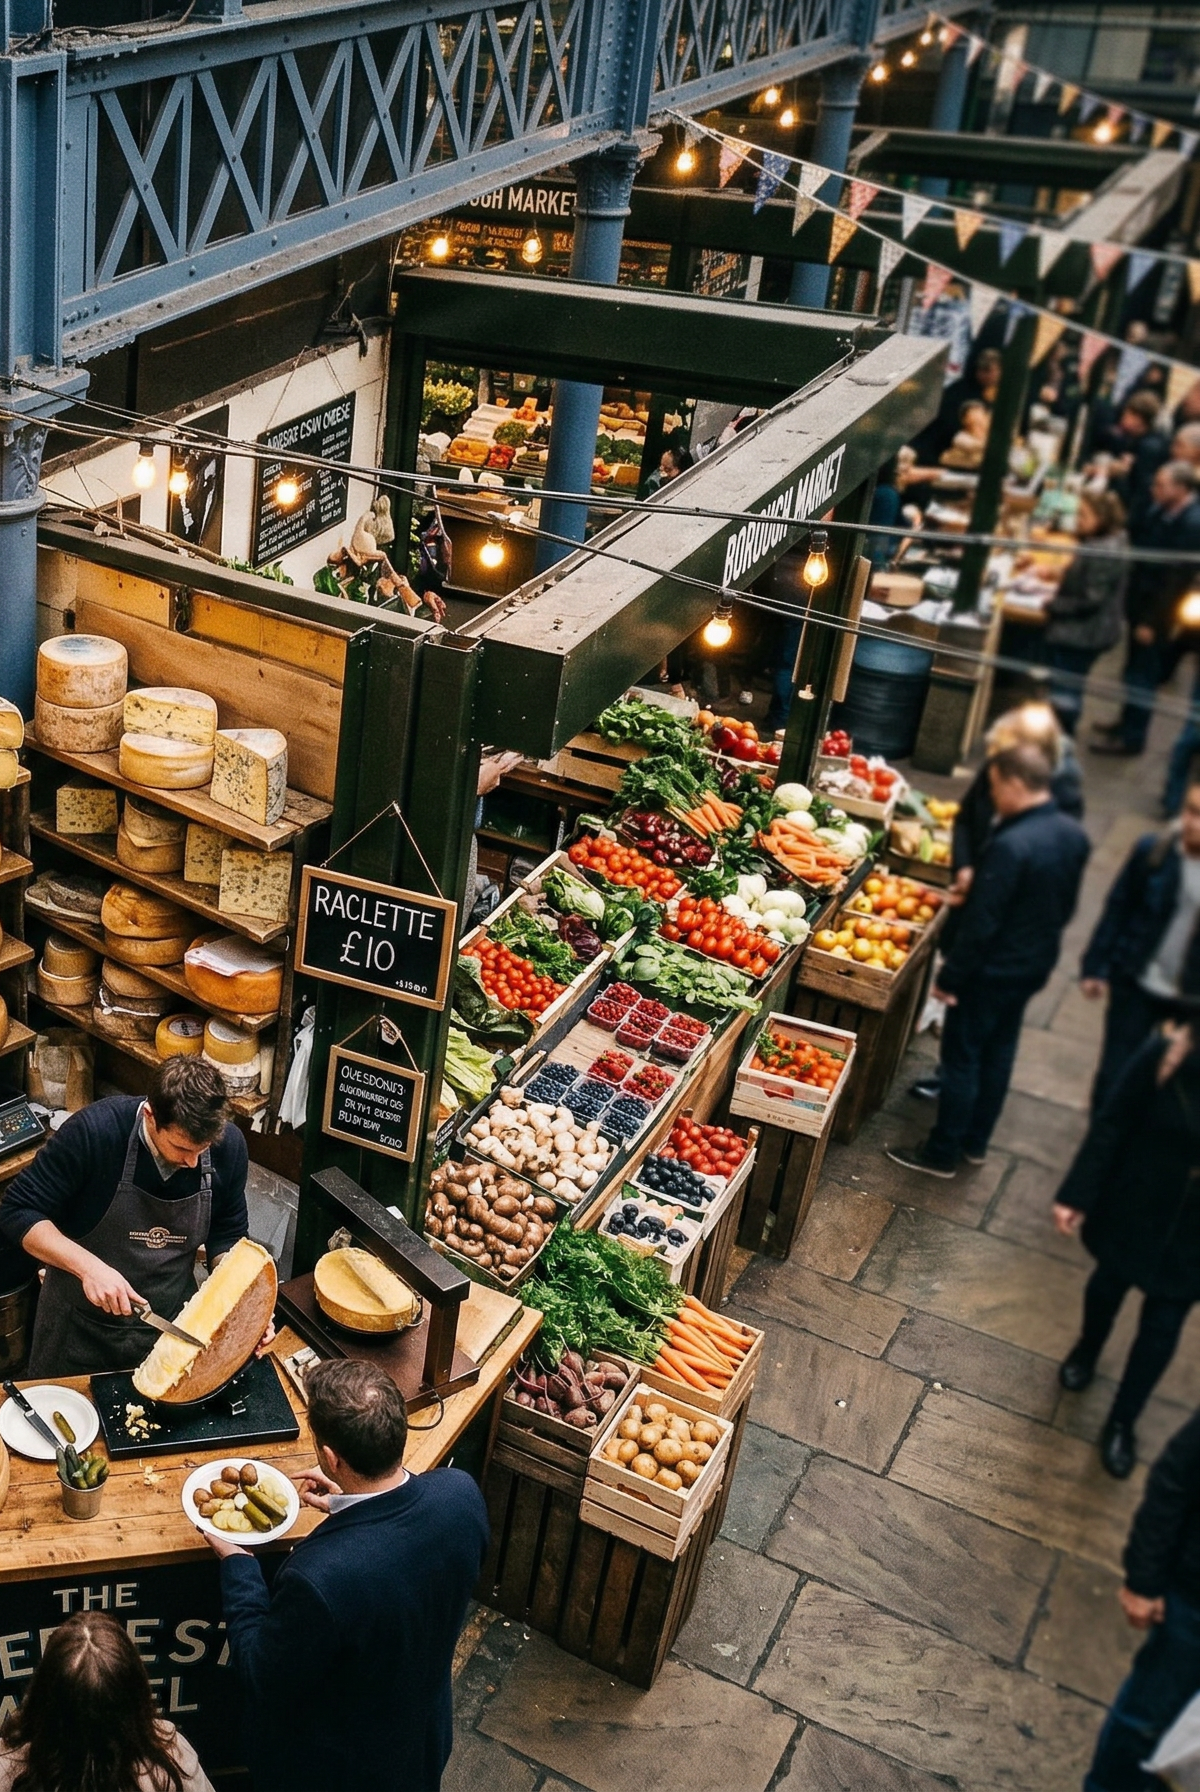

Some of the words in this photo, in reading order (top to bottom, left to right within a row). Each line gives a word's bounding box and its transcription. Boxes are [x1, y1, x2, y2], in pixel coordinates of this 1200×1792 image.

[722, 486, 794, 588] BOROUGH
[794, 443, 846, 522] MARKET
[314, 885, 436, 940] RACLETTE
[339, 930, 396, 972] £10
[53, 1582, 139, 1613] THE
